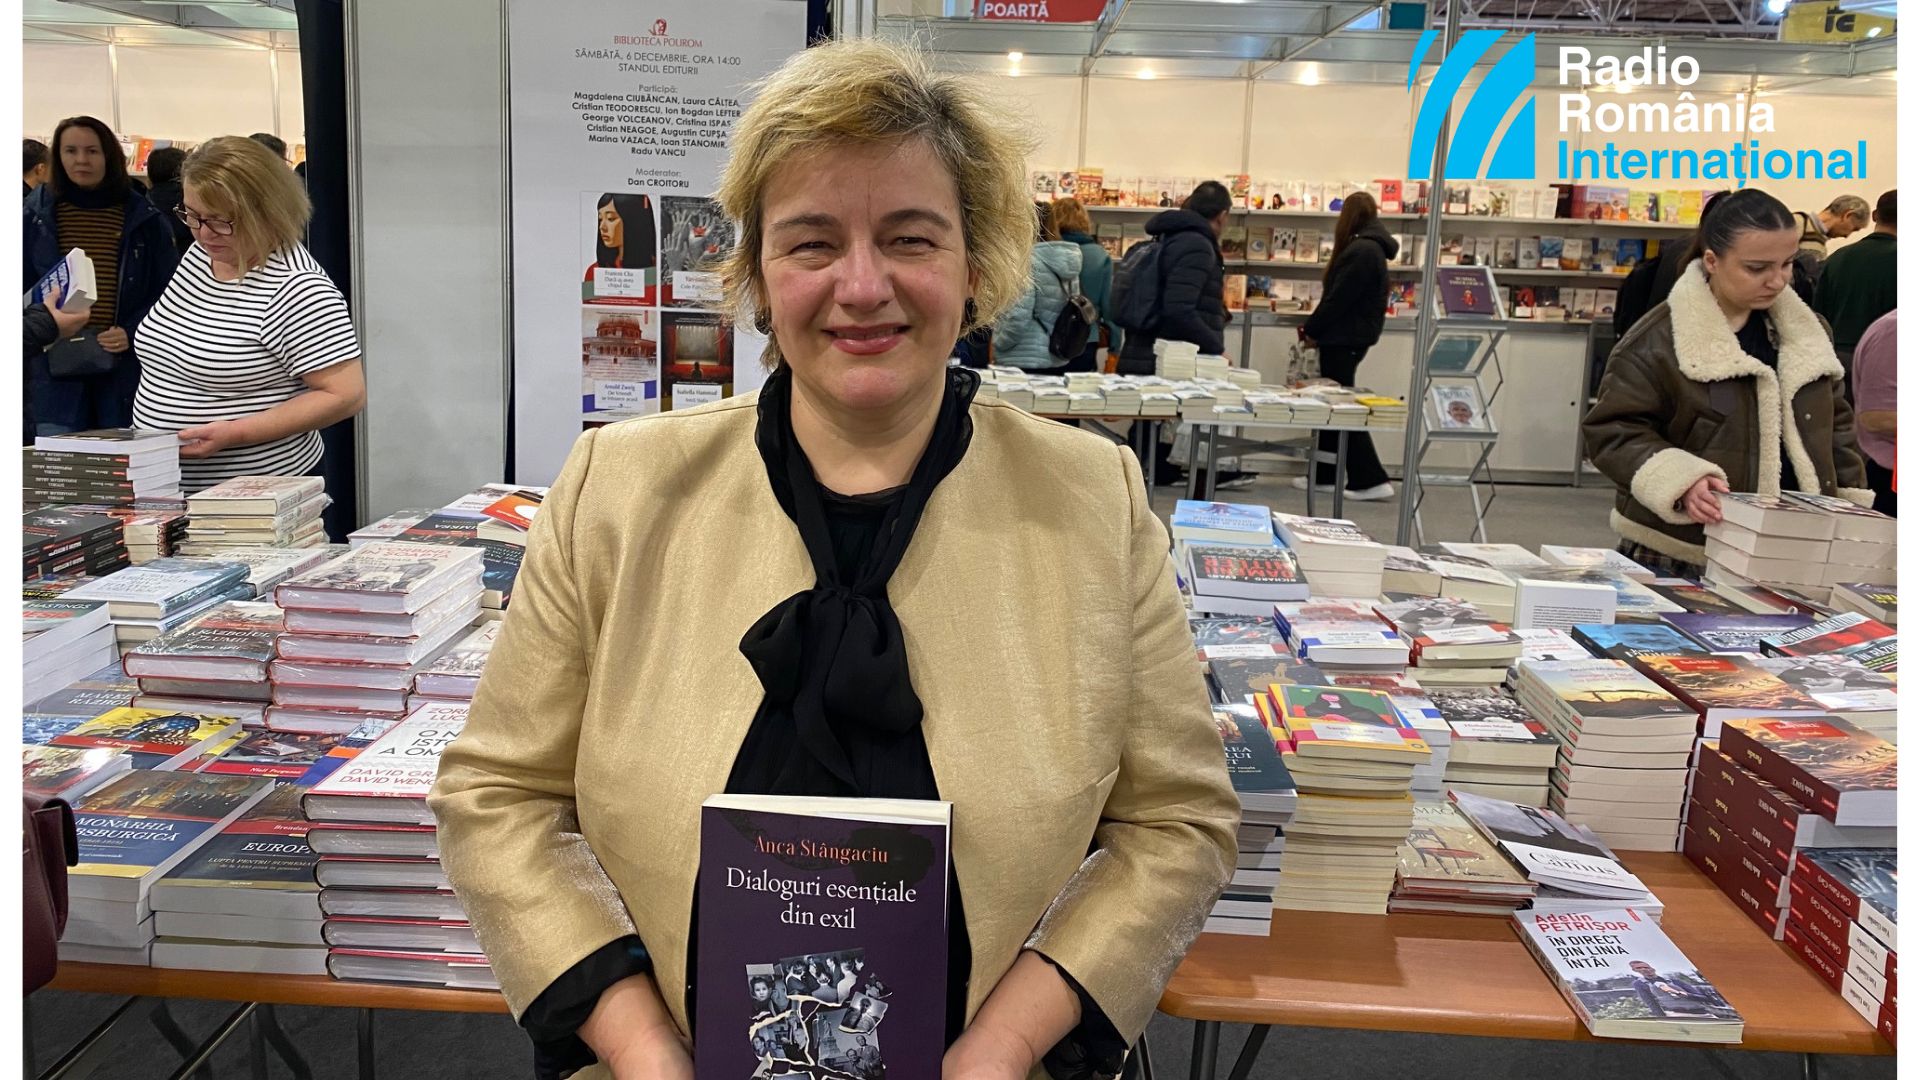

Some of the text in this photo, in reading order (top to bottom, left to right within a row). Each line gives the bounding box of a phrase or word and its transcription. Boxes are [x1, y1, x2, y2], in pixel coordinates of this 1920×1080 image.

[984, 1, 1049, 17] POARTĂ
[614, 35, 661, 46] BIBLIOTECA
[575, 48, 741, 66] SÂMBĂTĂ, 6 DECEMBRIE, ORA 14:00
[618, 63, 698, 75] STANDUL EDITURII
[638, 84, 678, 94] Participă:
[574, 92, 623, 102] Magdalena
[682, 97, 706, 106] Laura
[572, 103, 604, 112] Cristian
[606, 104, 663, 114] TEODORESCU,
[665, 107, 679, 115] Ion
[681, 108, 714, 117] Bogdan
[582, 113, 615, 123] George
[617, 114, 674, 126] VOLCEANOV,
[676, 118, 706, 127] Cristina
[587, 124, 618, 133] Cristian
[620, 125, 659, 135] NEAGOE,
[661, 128, 697, 138] Augustin
[589, 135, 727, 149] Marina VAZACA, Ioan STANOMIR,
[631, 147, 686, 157] Radu VANCU
[635, 168, 681, 178] Moderator:
[628, 178, 690, 188] Dan CROITORU
[28, 602, 92, 611] HASTINGS
[378, 747, 395, 755] A
[349, 768, 404, 776] DAVID
[338, 775, 389, 783] DAVID
[75, 817, 175, 831] MONARHIA
[76, 827, 181, 841] BSBURGICĂ
[754, 836, 889, 865] Anca Stângaciu
[1529, 853, 1617, 876] Camus
[726, 867, 917, 905] Dialoguri esențiale
[780, 902, 856, 929] din exil
[1535, 912, 1593, 924] Adelin
[1538, 921, 1632, 933] PETRIȘOR
[1546, 935, 1622, 947] ÎN DIRECT
[1556, 945, 1630, 958] DIN LINIA
[1562, 956, 1610, 969] ÎNTÂI
